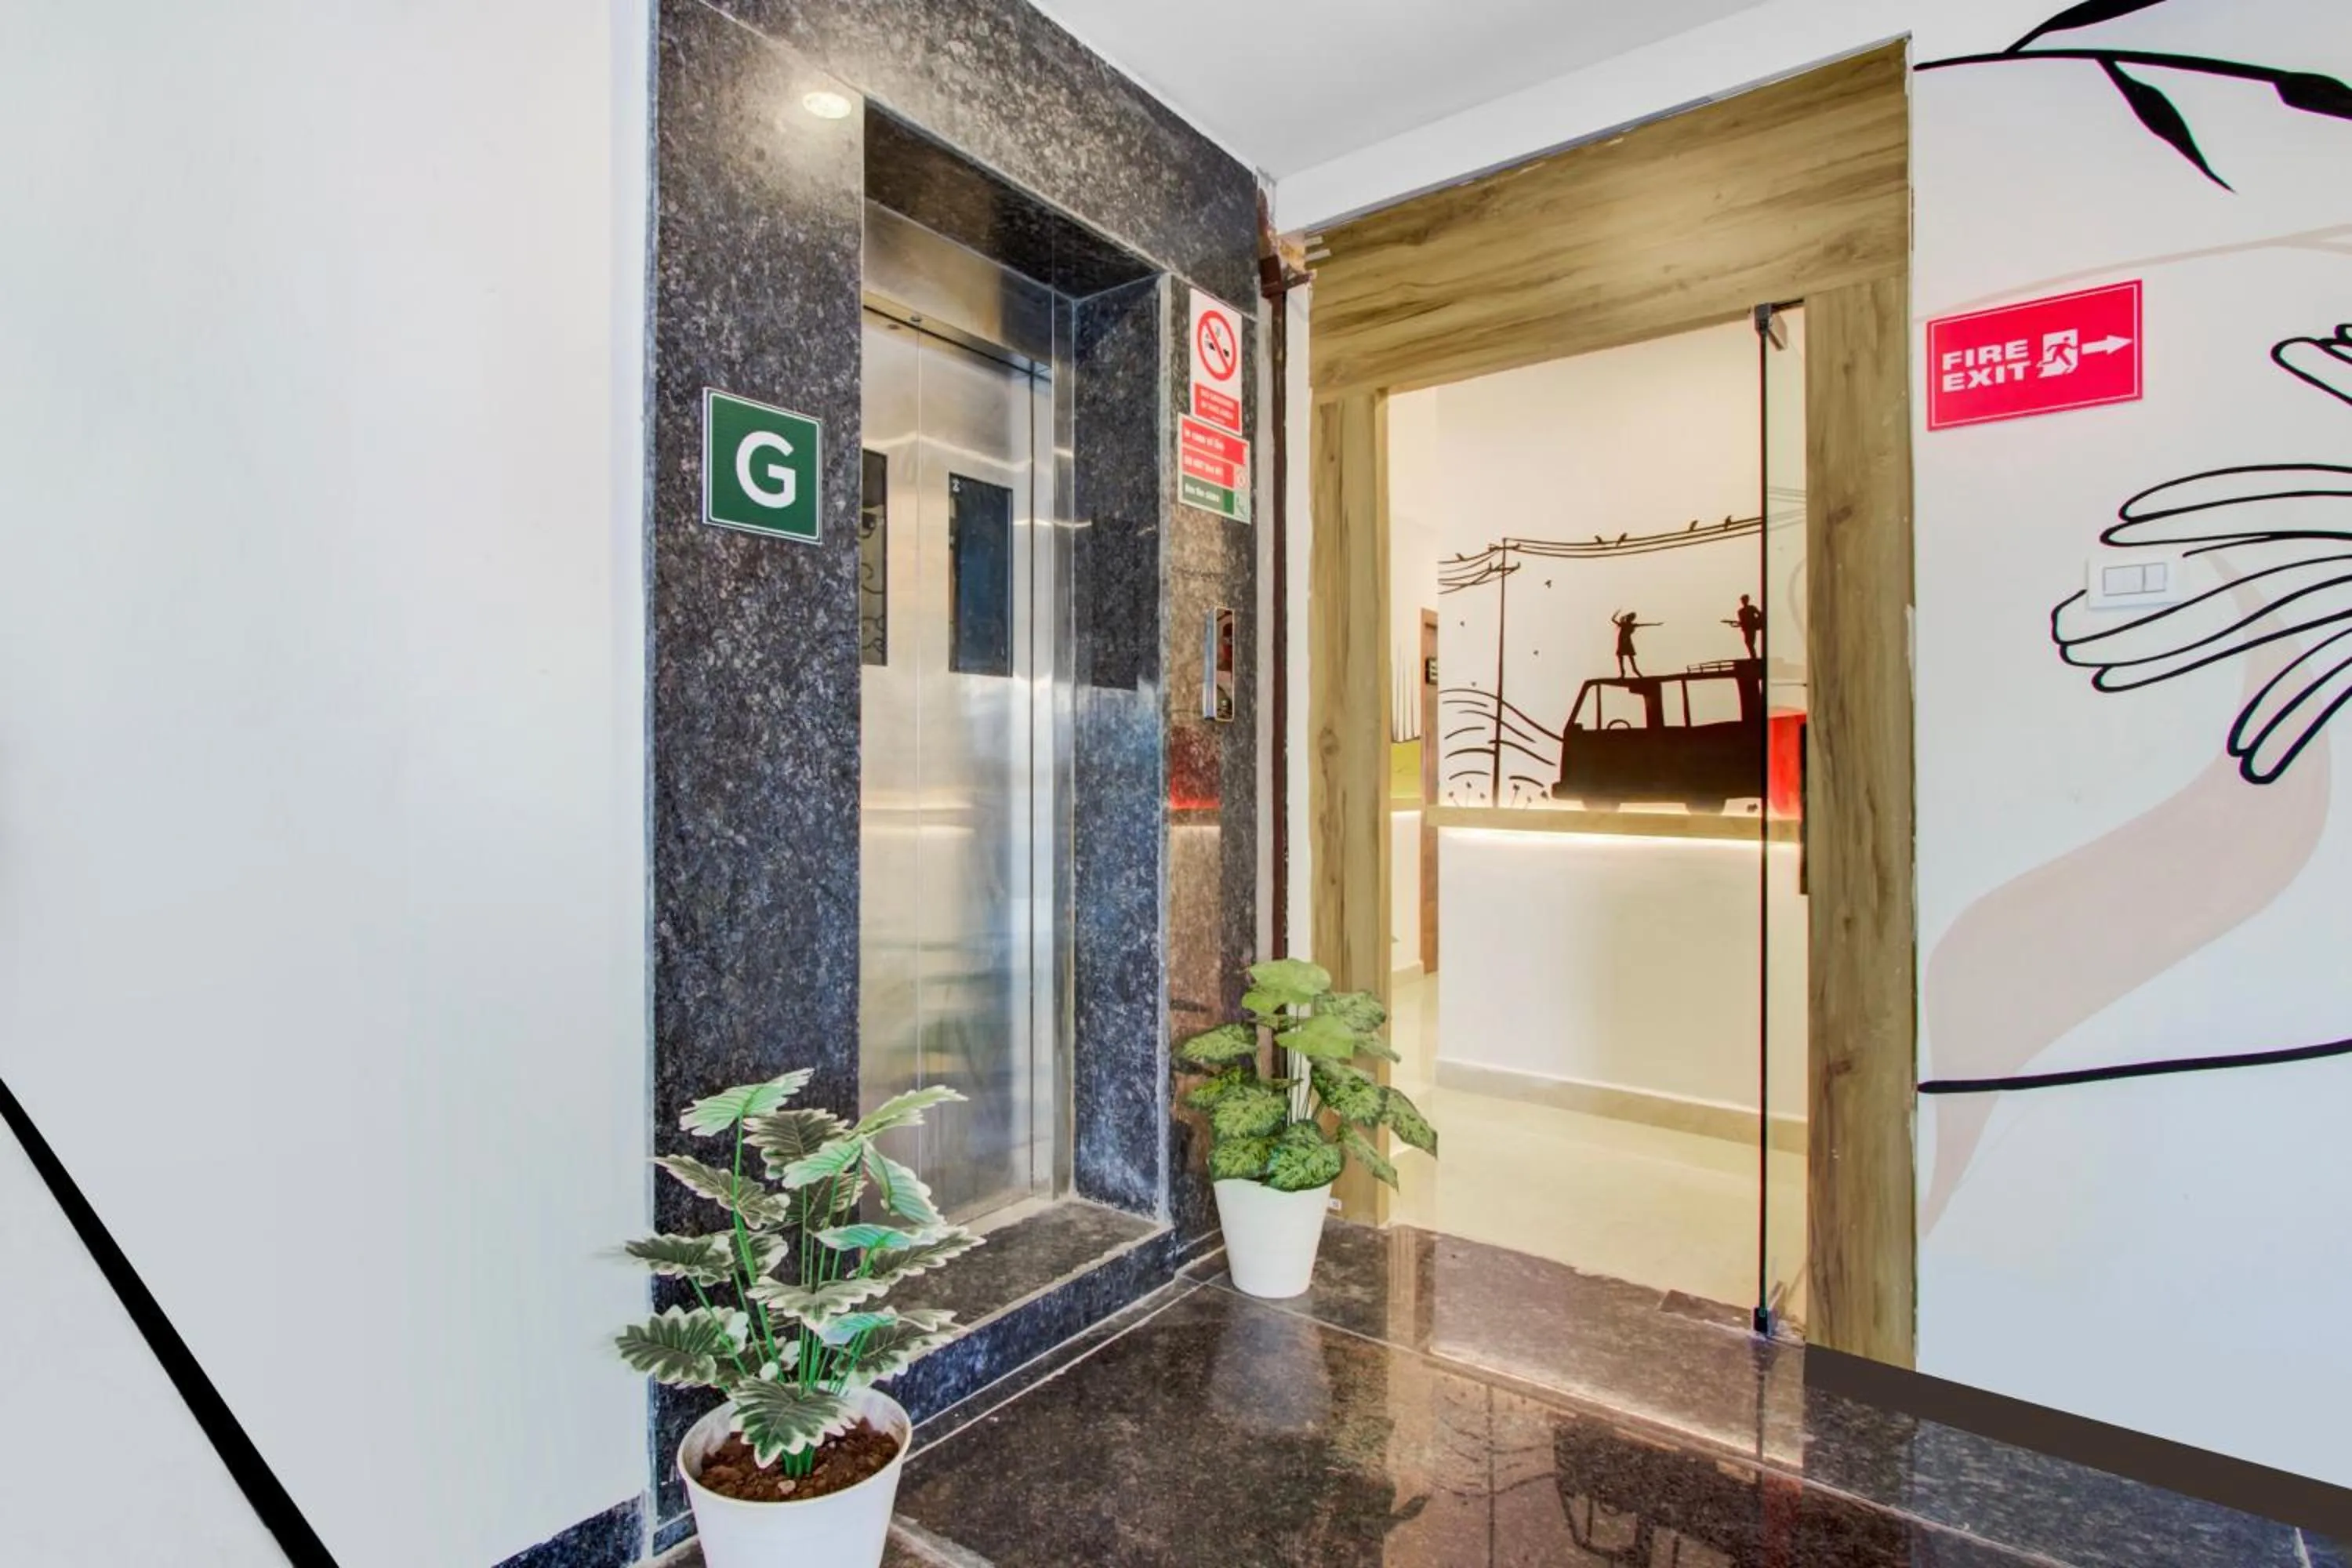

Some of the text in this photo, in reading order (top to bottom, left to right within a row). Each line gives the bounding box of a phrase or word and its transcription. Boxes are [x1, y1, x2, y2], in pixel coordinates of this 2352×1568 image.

[1942, 339, 2029, 371] FIRE
[1942, 361, 2031, 393] EXIT
[736, 430, 796, 509] G
